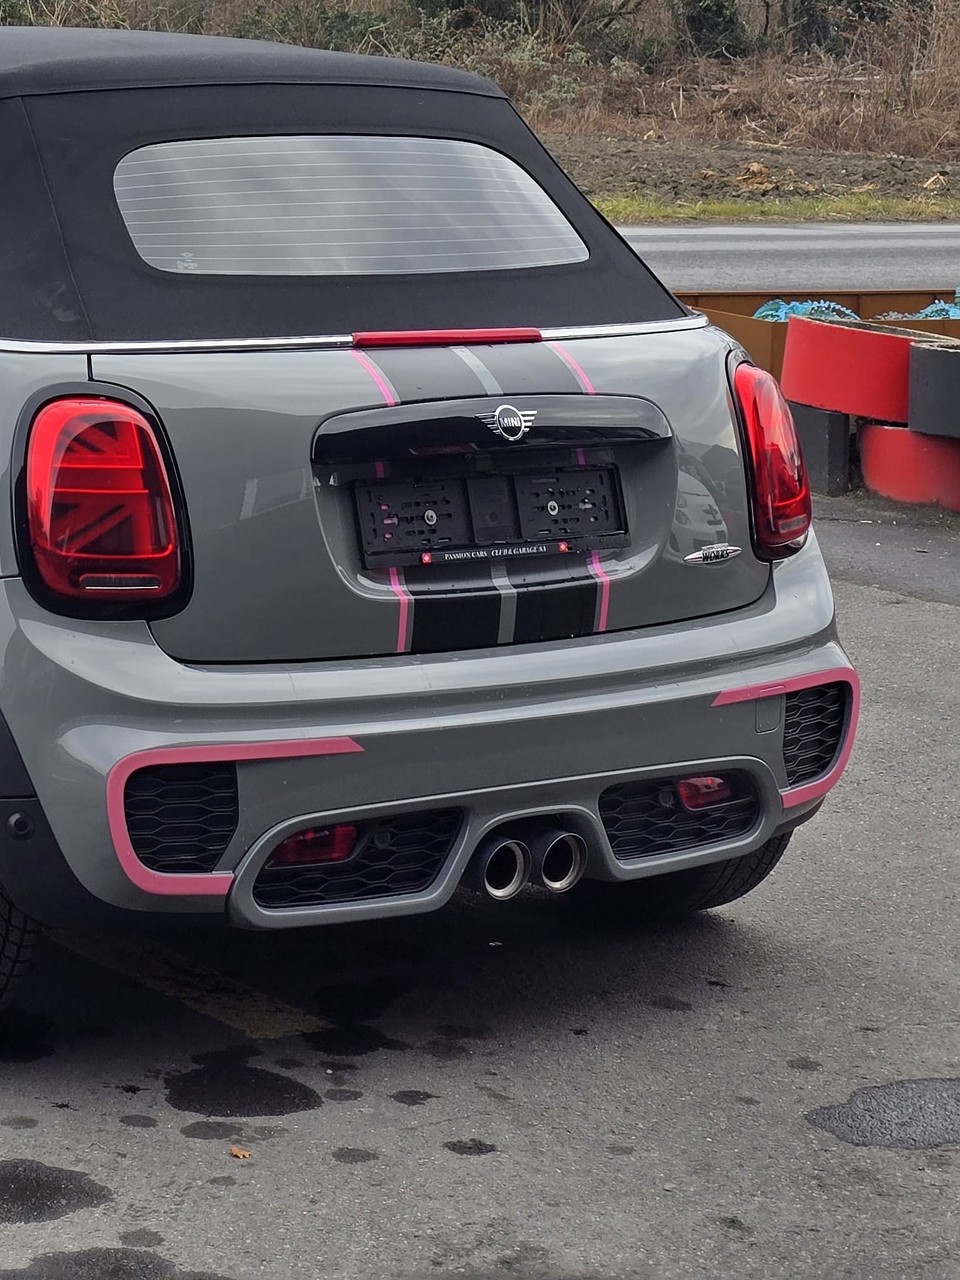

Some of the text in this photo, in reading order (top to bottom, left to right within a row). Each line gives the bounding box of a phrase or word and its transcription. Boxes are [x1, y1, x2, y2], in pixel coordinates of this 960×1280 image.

[499, 416, 521, 427] MINI
[444, 552, 470, 560] PASSION
[471, 550, 488, 558] CARS
[513, 546, 537, 555] GARAGE
[701, 549, 730, 562] WORKS
